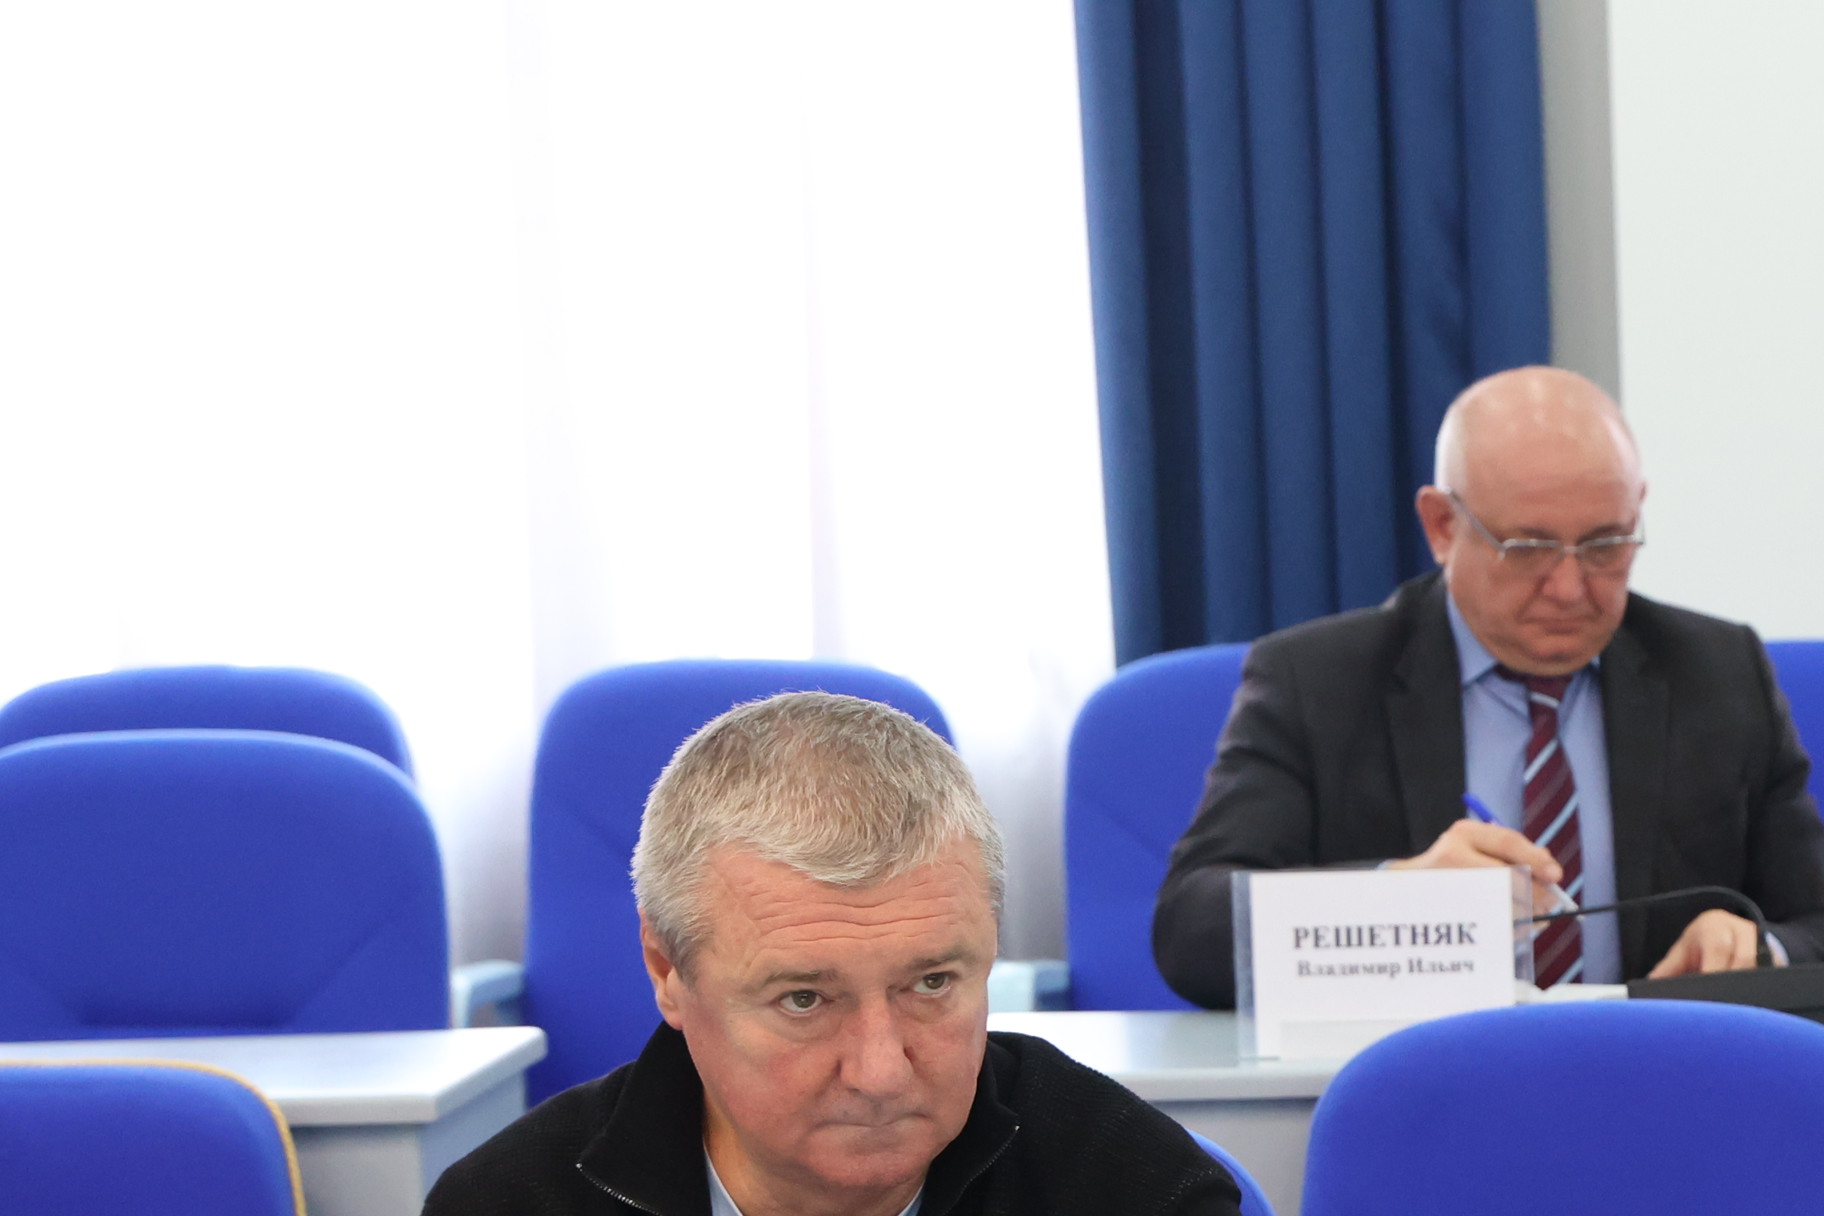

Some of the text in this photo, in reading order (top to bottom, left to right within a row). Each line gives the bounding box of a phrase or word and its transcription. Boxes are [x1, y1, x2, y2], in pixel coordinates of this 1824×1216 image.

[1293, 922, 1476, 949] РЕШЕТНЯК
[1297, 957, 1474, 979] Владимир Ильич
